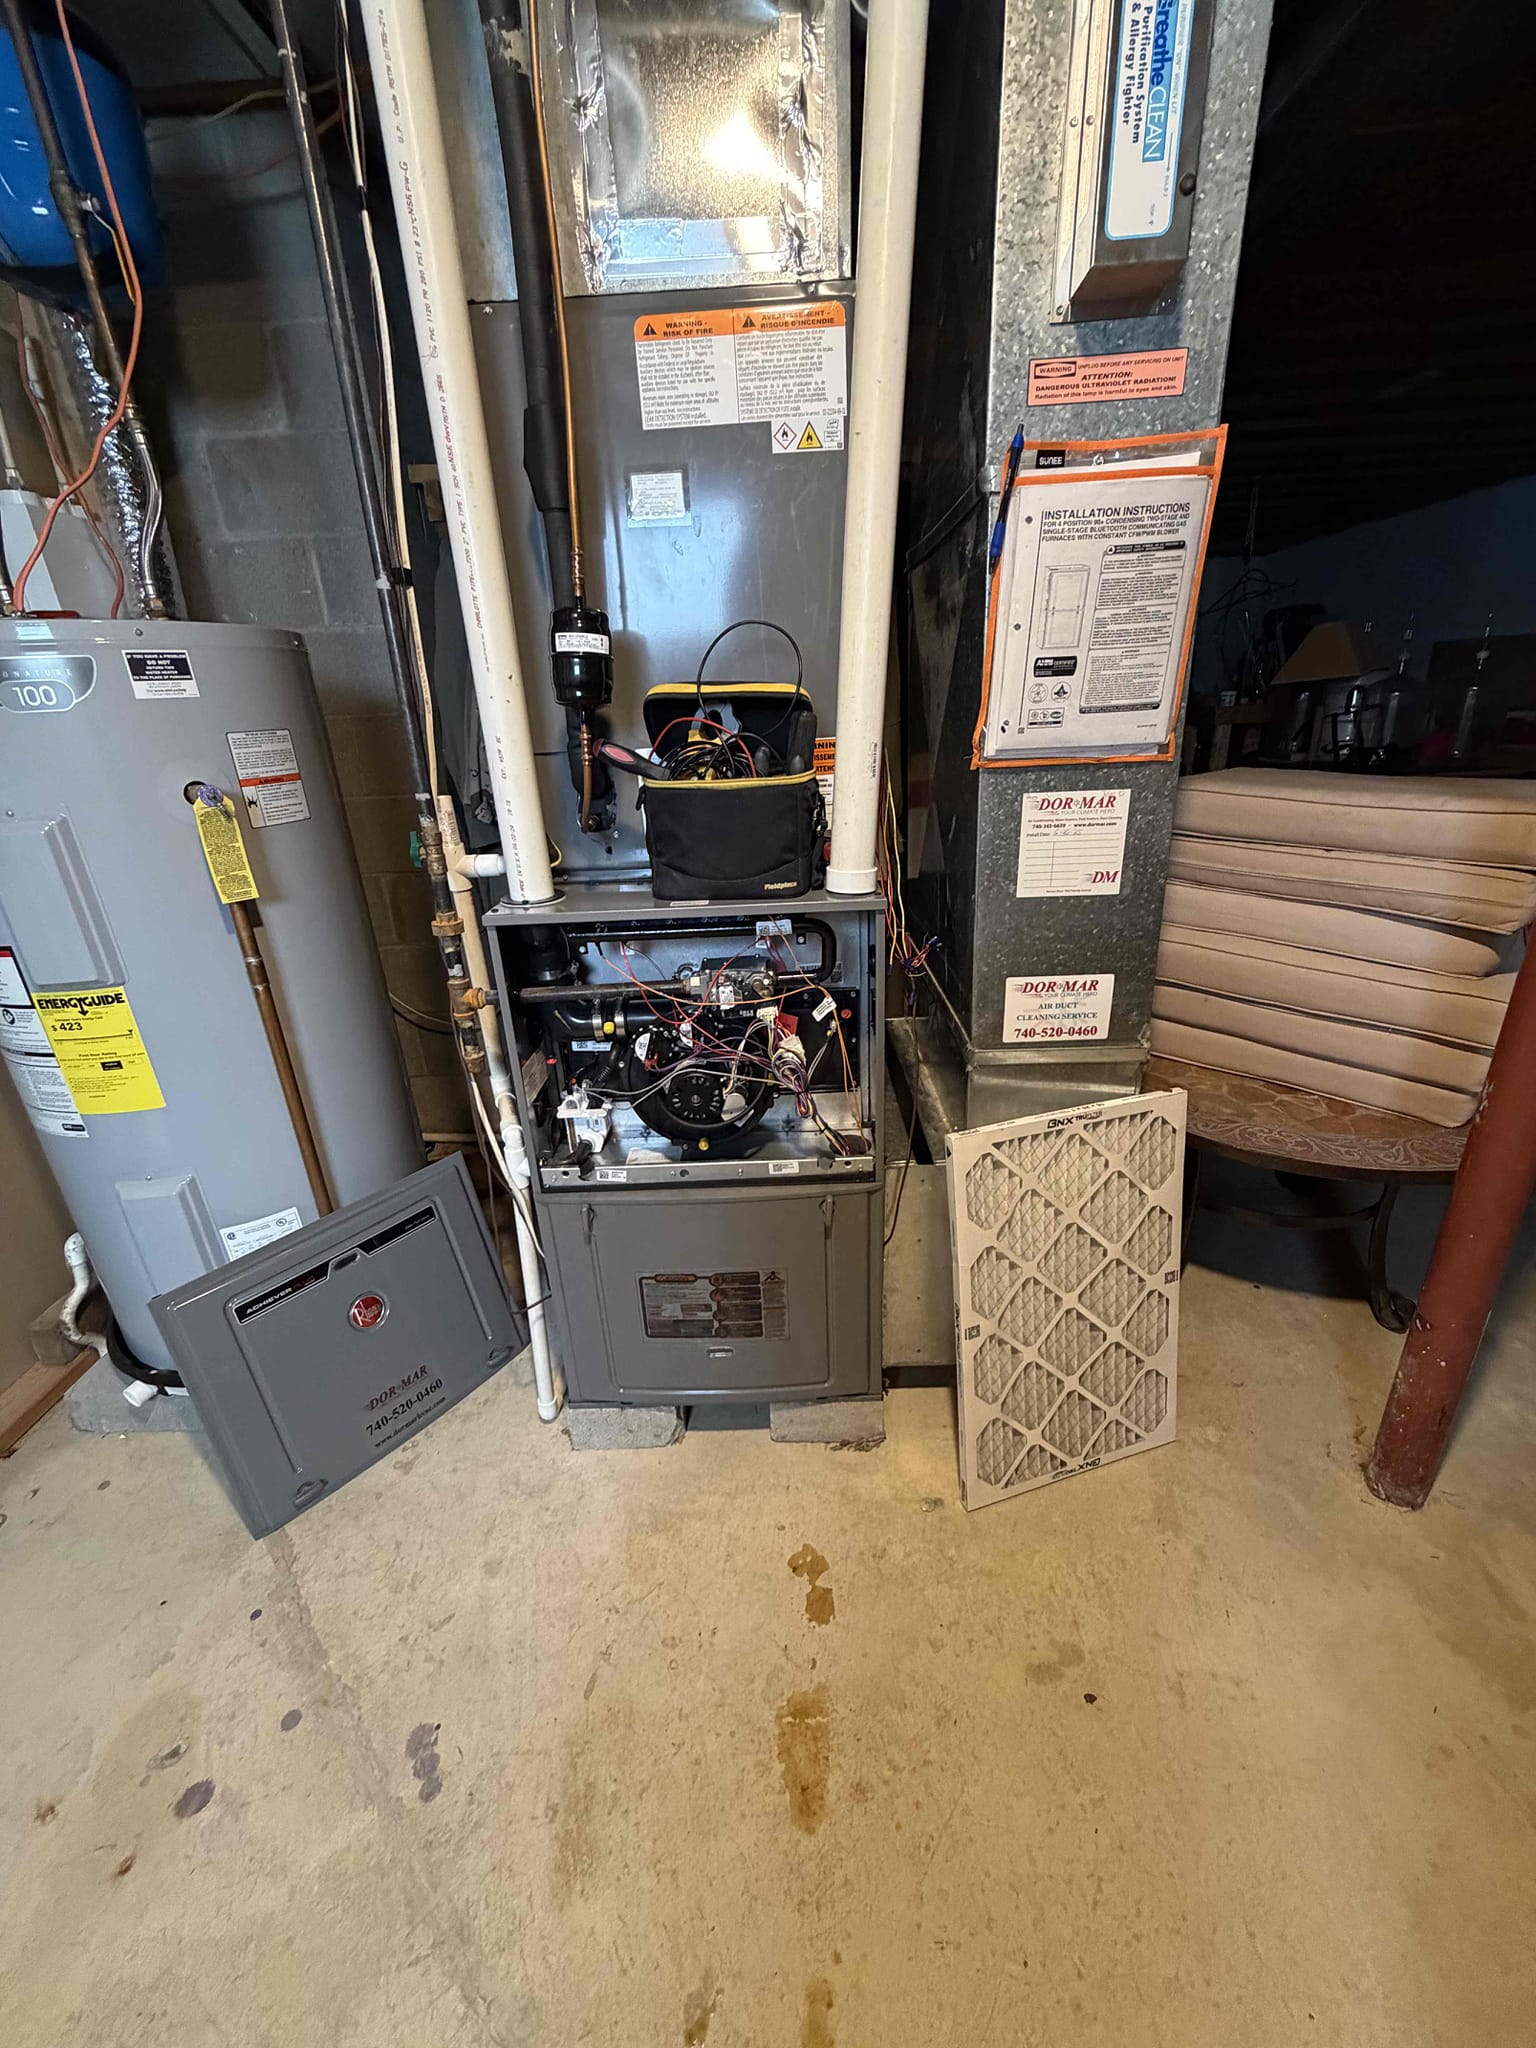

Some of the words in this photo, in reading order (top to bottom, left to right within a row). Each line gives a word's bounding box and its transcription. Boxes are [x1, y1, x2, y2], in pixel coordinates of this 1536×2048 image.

[1131, 2, 1140, 13] &
[1124, 19, 1140, 70] Allergy
[1137, 6, 1154, 90] Purification
[391, 93, 400, 117] Code
[1122, 75, 1135, 125] Fighter
[1132, 94, 1145, 144] System
[665, 320, 703, 329] WARNING
[760, 320, 789, 329] RISQUE
[1039, 365, 1072, 374] WARNING
[1081, 371, 1133, 381] ATTENTION:
[1035, 383, 1080, 392] DANGEROUS
[1082, 380, 1131, 389] ULTRAVIOLET
[1133, 376, 1176, 385] RADIATION!
[1035, 392, 1063, 400] Radiation
[1082, 390, 1098, 398] lamp
[1105, 387, 1128, 395] harmful
[456, 500, 465, 516] TYPE
[1044, 506, 1121, 521] INSTALLATION
[1122, 502, 1191, 516] INSTRUCTIONS
[1042, 526, 1089, 535] SINGLE-STAGE
[1090, 524, 1127, 533] BLUETOOTH
[1128, 521, 1176, 531] COMMUNICATING
[1063, 519, 1093, 527] POSITION
[1105, 516, 1146, 525] CONDENSING
[1146, 514, 1178, 522] TWO-STAGE
[1041, 534, 1076, 543] FURNACES
[1077, 532, 1093, 541] WITH
[1094, 531, 1127, 540] CONSTANT
[1156, 528, 1180, 536] BLOWER
[471, 594, 483, 629] CHARLOTTE
[11, 685, 57, 706] 100
[1091, 870, 1120, 884] DM
[36, 993, 125, 1011] ENERGYGUIDE
[1054, 1002, 1079, 1010] DUCT
[1016, 1013, 1060, 1022] CLEANING
[1061, 1012, 1098, 1020] SERVICE
[59, 1022, 83, 1032] 423
[1014, 1025, 1098, 1038] 740-520-0460
[245, 1287, 293, 1314] ACHIEVER
[365, 1378, 444, 1436] 740-520-0460
